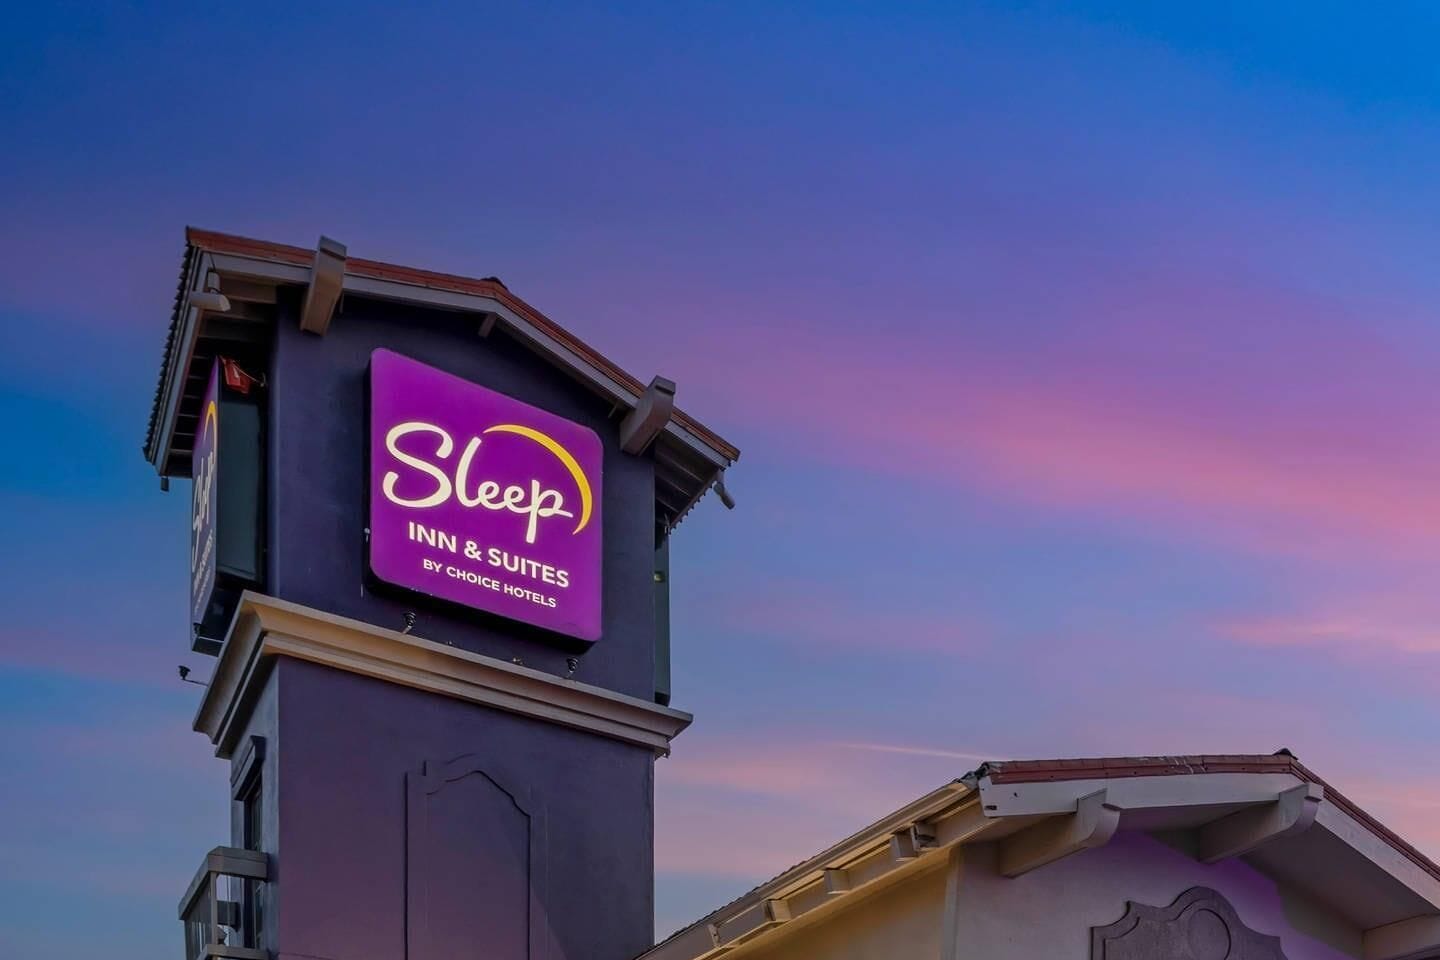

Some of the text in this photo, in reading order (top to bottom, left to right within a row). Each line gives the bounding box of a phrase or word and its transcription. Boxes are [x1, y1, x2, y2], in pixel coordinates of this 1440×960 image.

[382, 421, 574, 544] Sleep
[408, 521, 569, 588] INN & SUITES
[423, 558, 557, 608] BY CHOICE HOTELS
